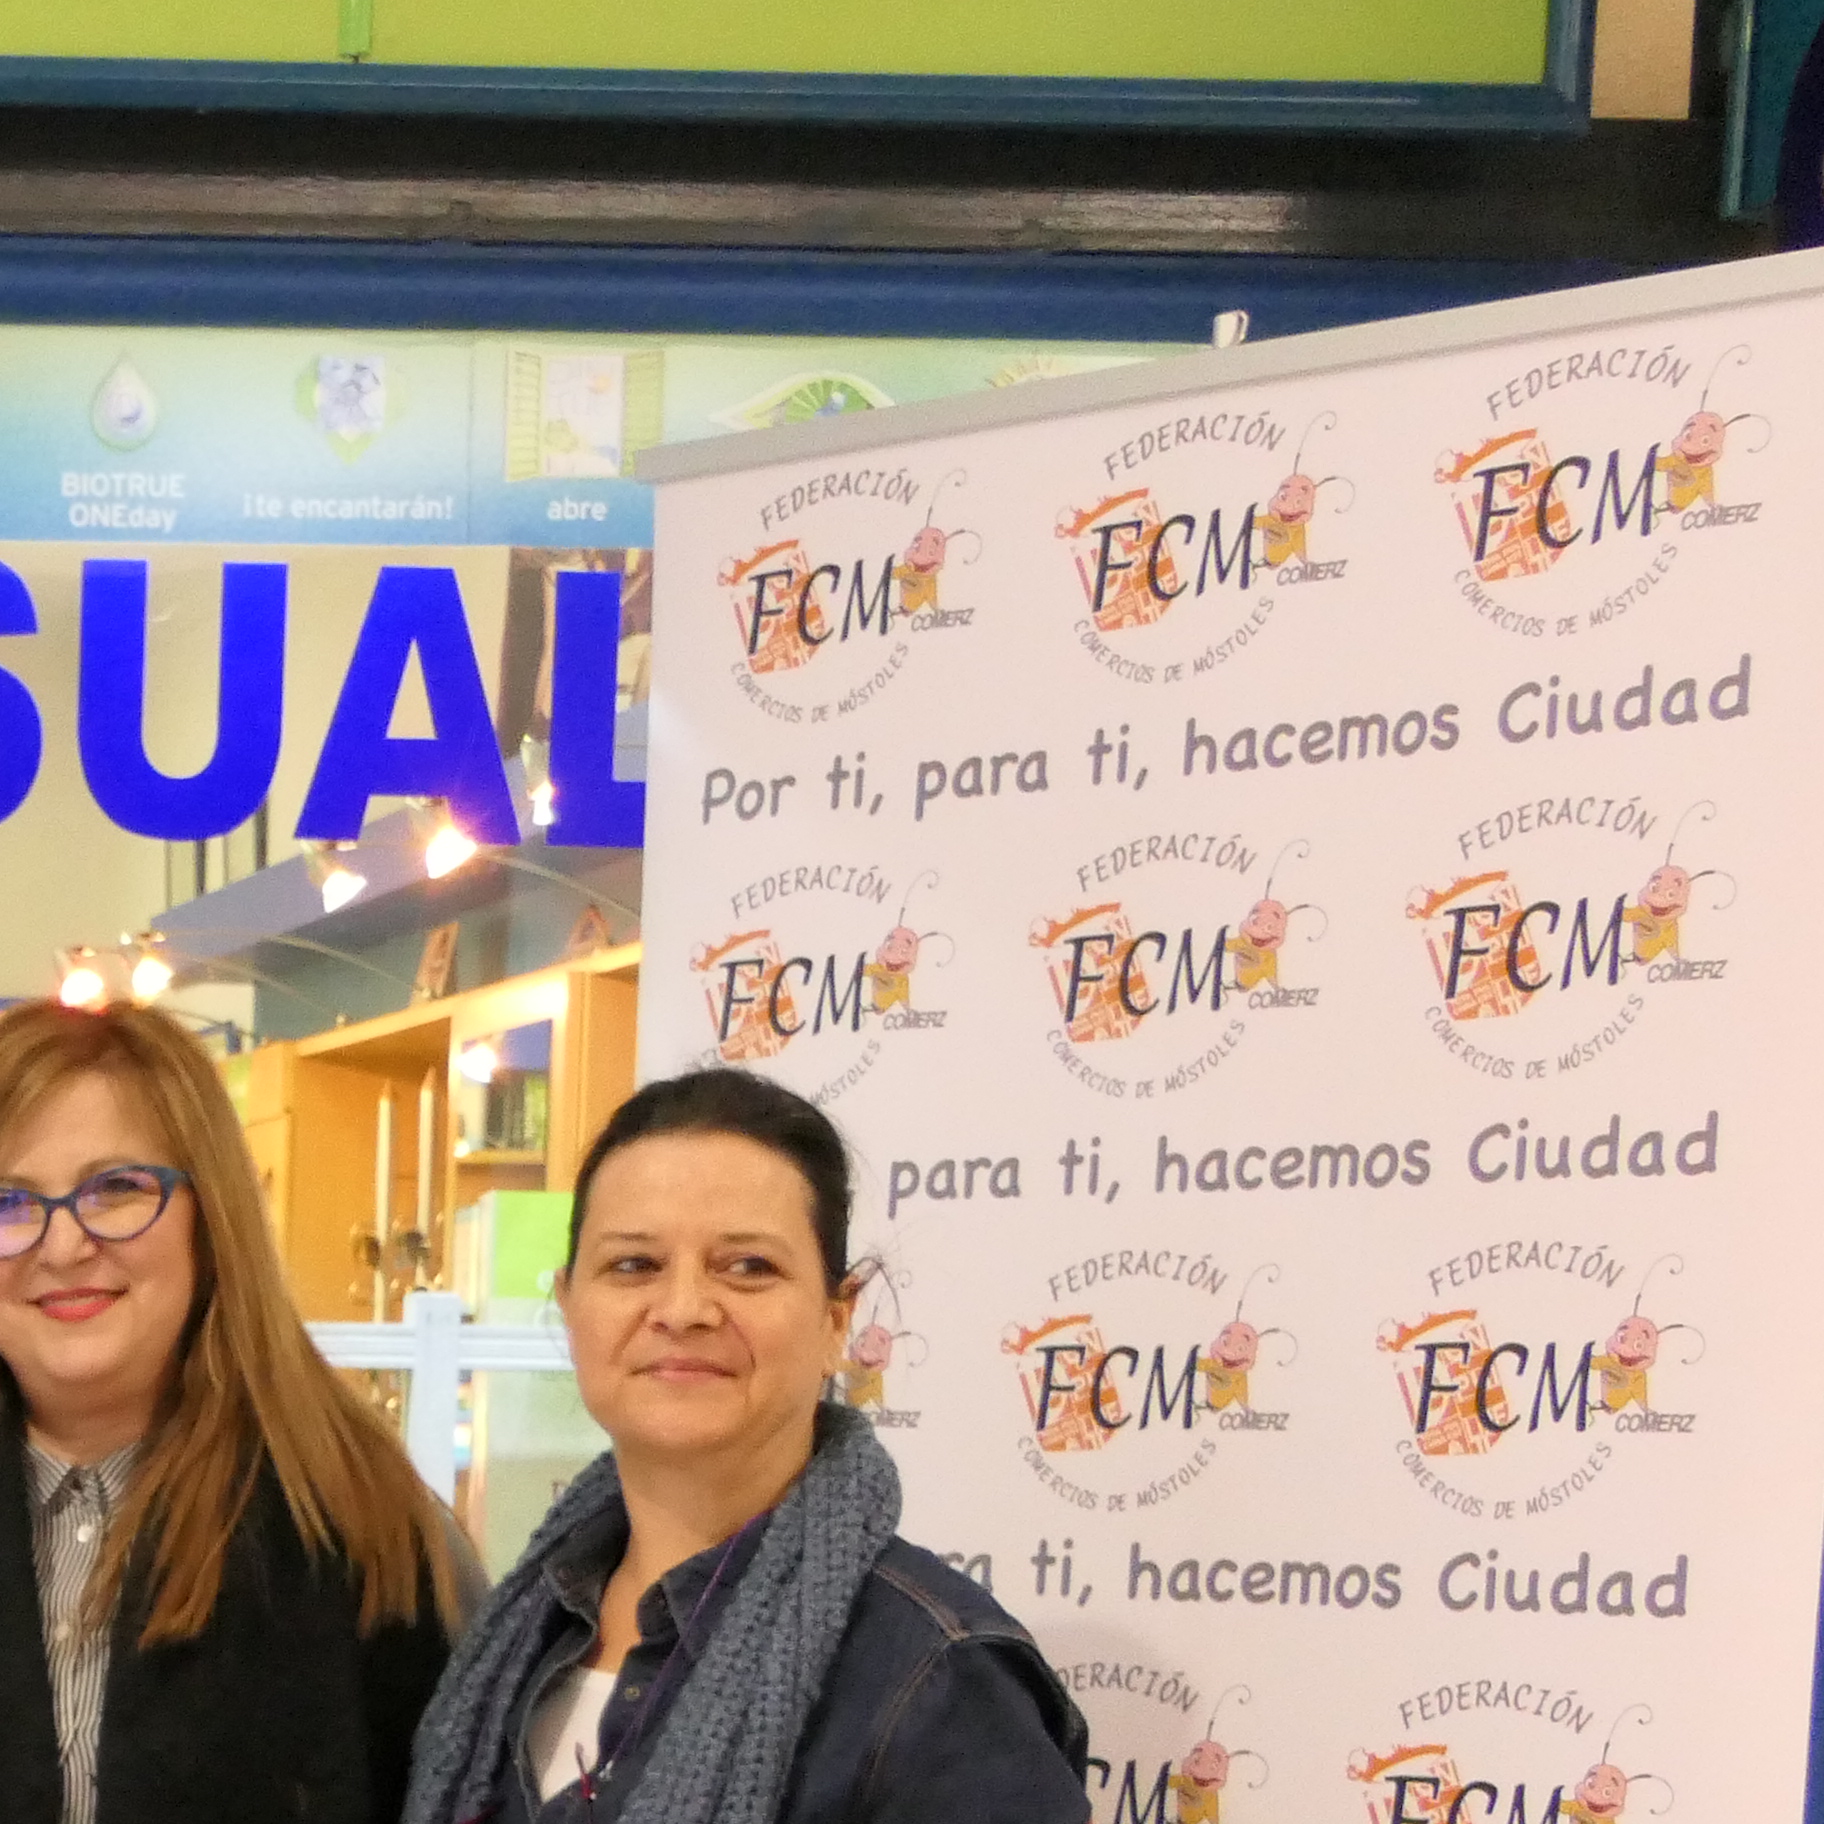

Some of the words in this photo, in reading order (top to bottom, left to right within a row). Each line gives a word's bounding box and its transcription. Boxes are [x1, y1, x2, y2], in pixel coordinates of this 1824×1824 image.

[1482, 338, 1691, 421] FEDERACIÓN
[61, 472, 182, 497] BIOTRUE
[1104, 411, 1285, 480] FEDERACIÓN
[70, 503, 174, 527] ONEday
[292, 496, 452, 518] encantarán!
[548, 498, 607, 520] abre
[1473, 443, 1660, 561] FCM
[1092, 503, 1260, 612] FCM
[748, 554, 896, 655] FCM
[702, 768, 796, 824] Por
[826, 752, 883, 815] ti,
[915, 750, 1048, 821] para
[1087, 724, 1148, 790] ti,
[1184, 704, 1459, 775] hacemos
[1498, 653, 1751, 743] Ciudad
[1077, 833, 1256, 892] FEDERACIÓN
[1458, 796, 1657, 860] FEDERACIÓN
[1065, 925, 1231, 1022] FCM
[1444, 894, 1627, 999] FCM
[720, 952, 868, 1041] FCM
[1425, 998, 1518, 1079] COMERCIOS
[1525, 1060, 1545, 1079] DE
[1558, 994, 1644, 1072] MÓSTOLES
[888, 1157, 1021, 1220] para
[1059, 1137, 1120, 1204] ti,
[1156, 1135, 1430, 1192] hacemos
[1468, 1110, 1718, 1183] Ciudad
[1048, 1250, 1227, 1301] FEDERACIÓN
[1428, 1241, 1624, 1296] FEDERACIÓN
[1036, 1345, 1202, 1431] FCM
[1415, 1342, 1598, 1434] FCM
[1031, 1539, 1092, 1606] ti,
[1128, 1542, 1401, 1609] hacemos
[1439, 1549, 1688, 1618] Ciudad
[1399, 1680, 1593, 1734] FEDERACIÓN
